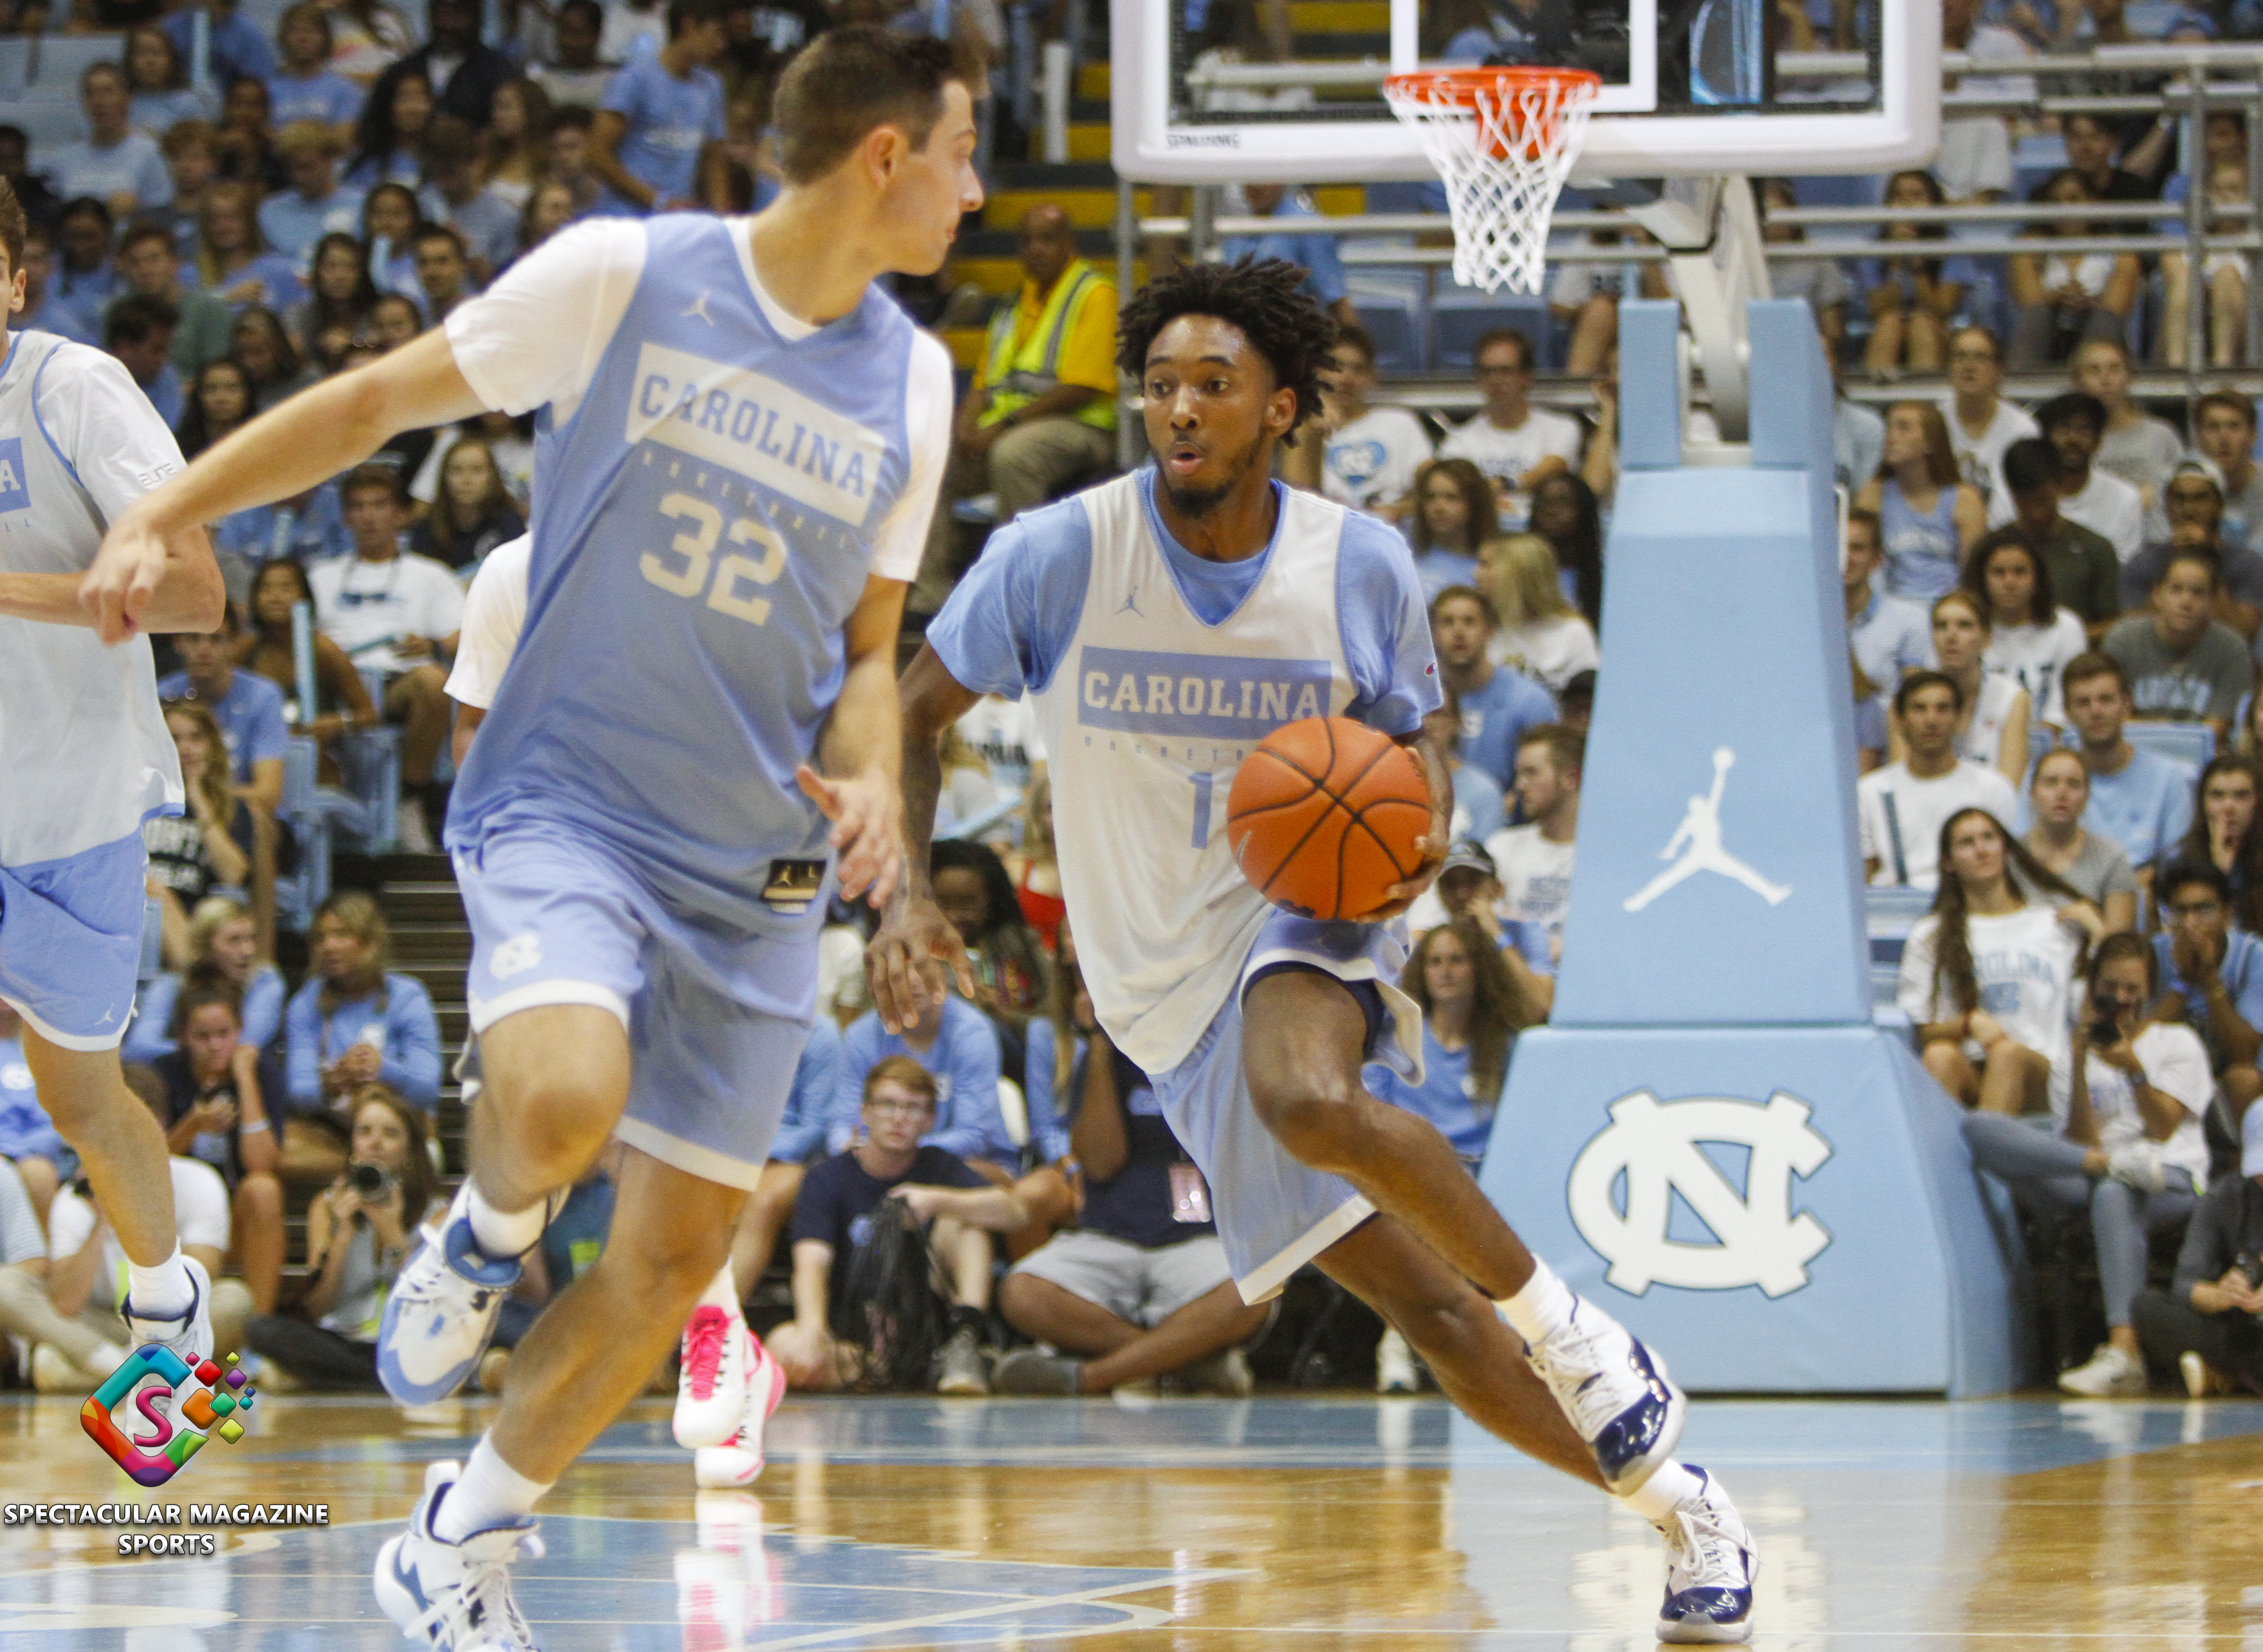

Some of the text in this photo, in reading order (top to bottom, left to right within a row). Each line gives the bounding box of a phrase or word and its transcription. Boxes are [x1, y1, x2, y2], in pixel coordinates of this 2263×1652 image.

[639, 374, 865, 498] CAROLINA
[639, 490, 788, 625] 32
[1084, 671, 1321, 720] CAROLINA
[1188, 771, 1213, 850] 1
